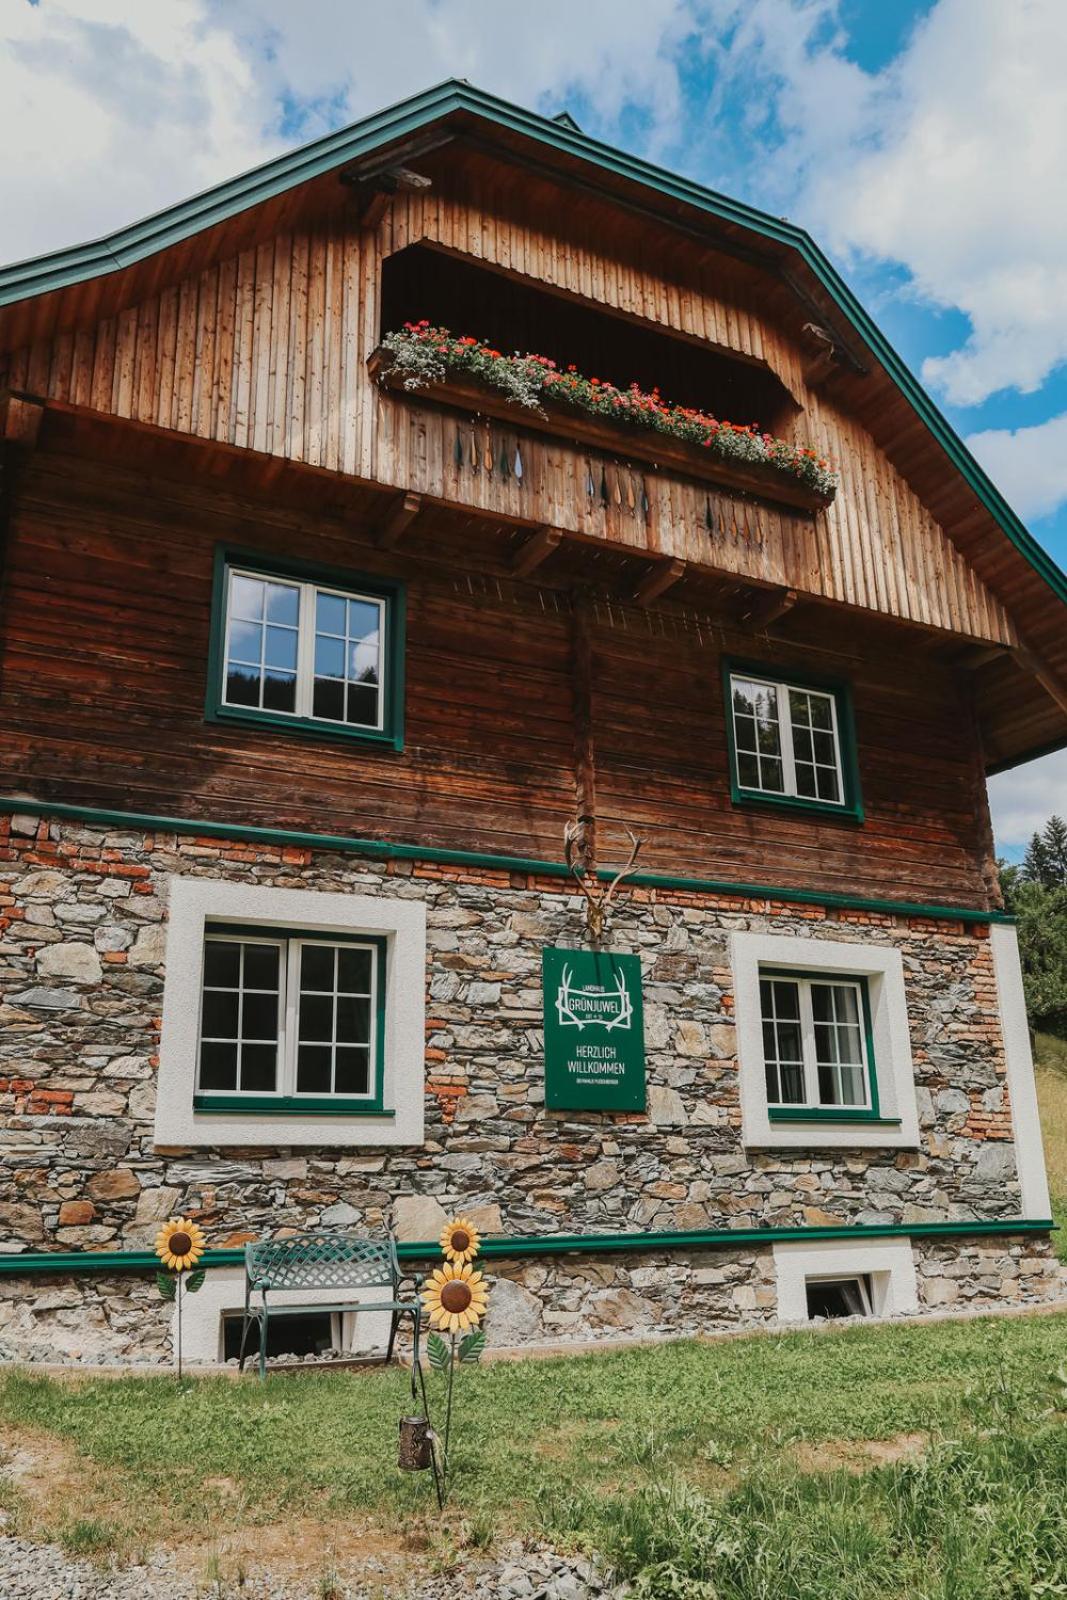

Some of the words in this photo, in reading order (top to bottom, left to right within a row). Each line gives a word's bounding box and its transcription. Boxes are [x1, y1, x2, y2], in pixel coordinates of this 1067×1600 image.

[569, 997, 620, 1013] GRÜNJUWEL
[576, 1045, 616, 1058] HERZLICH
[568, 1061, 625, 1074] WILLKOMMEN
